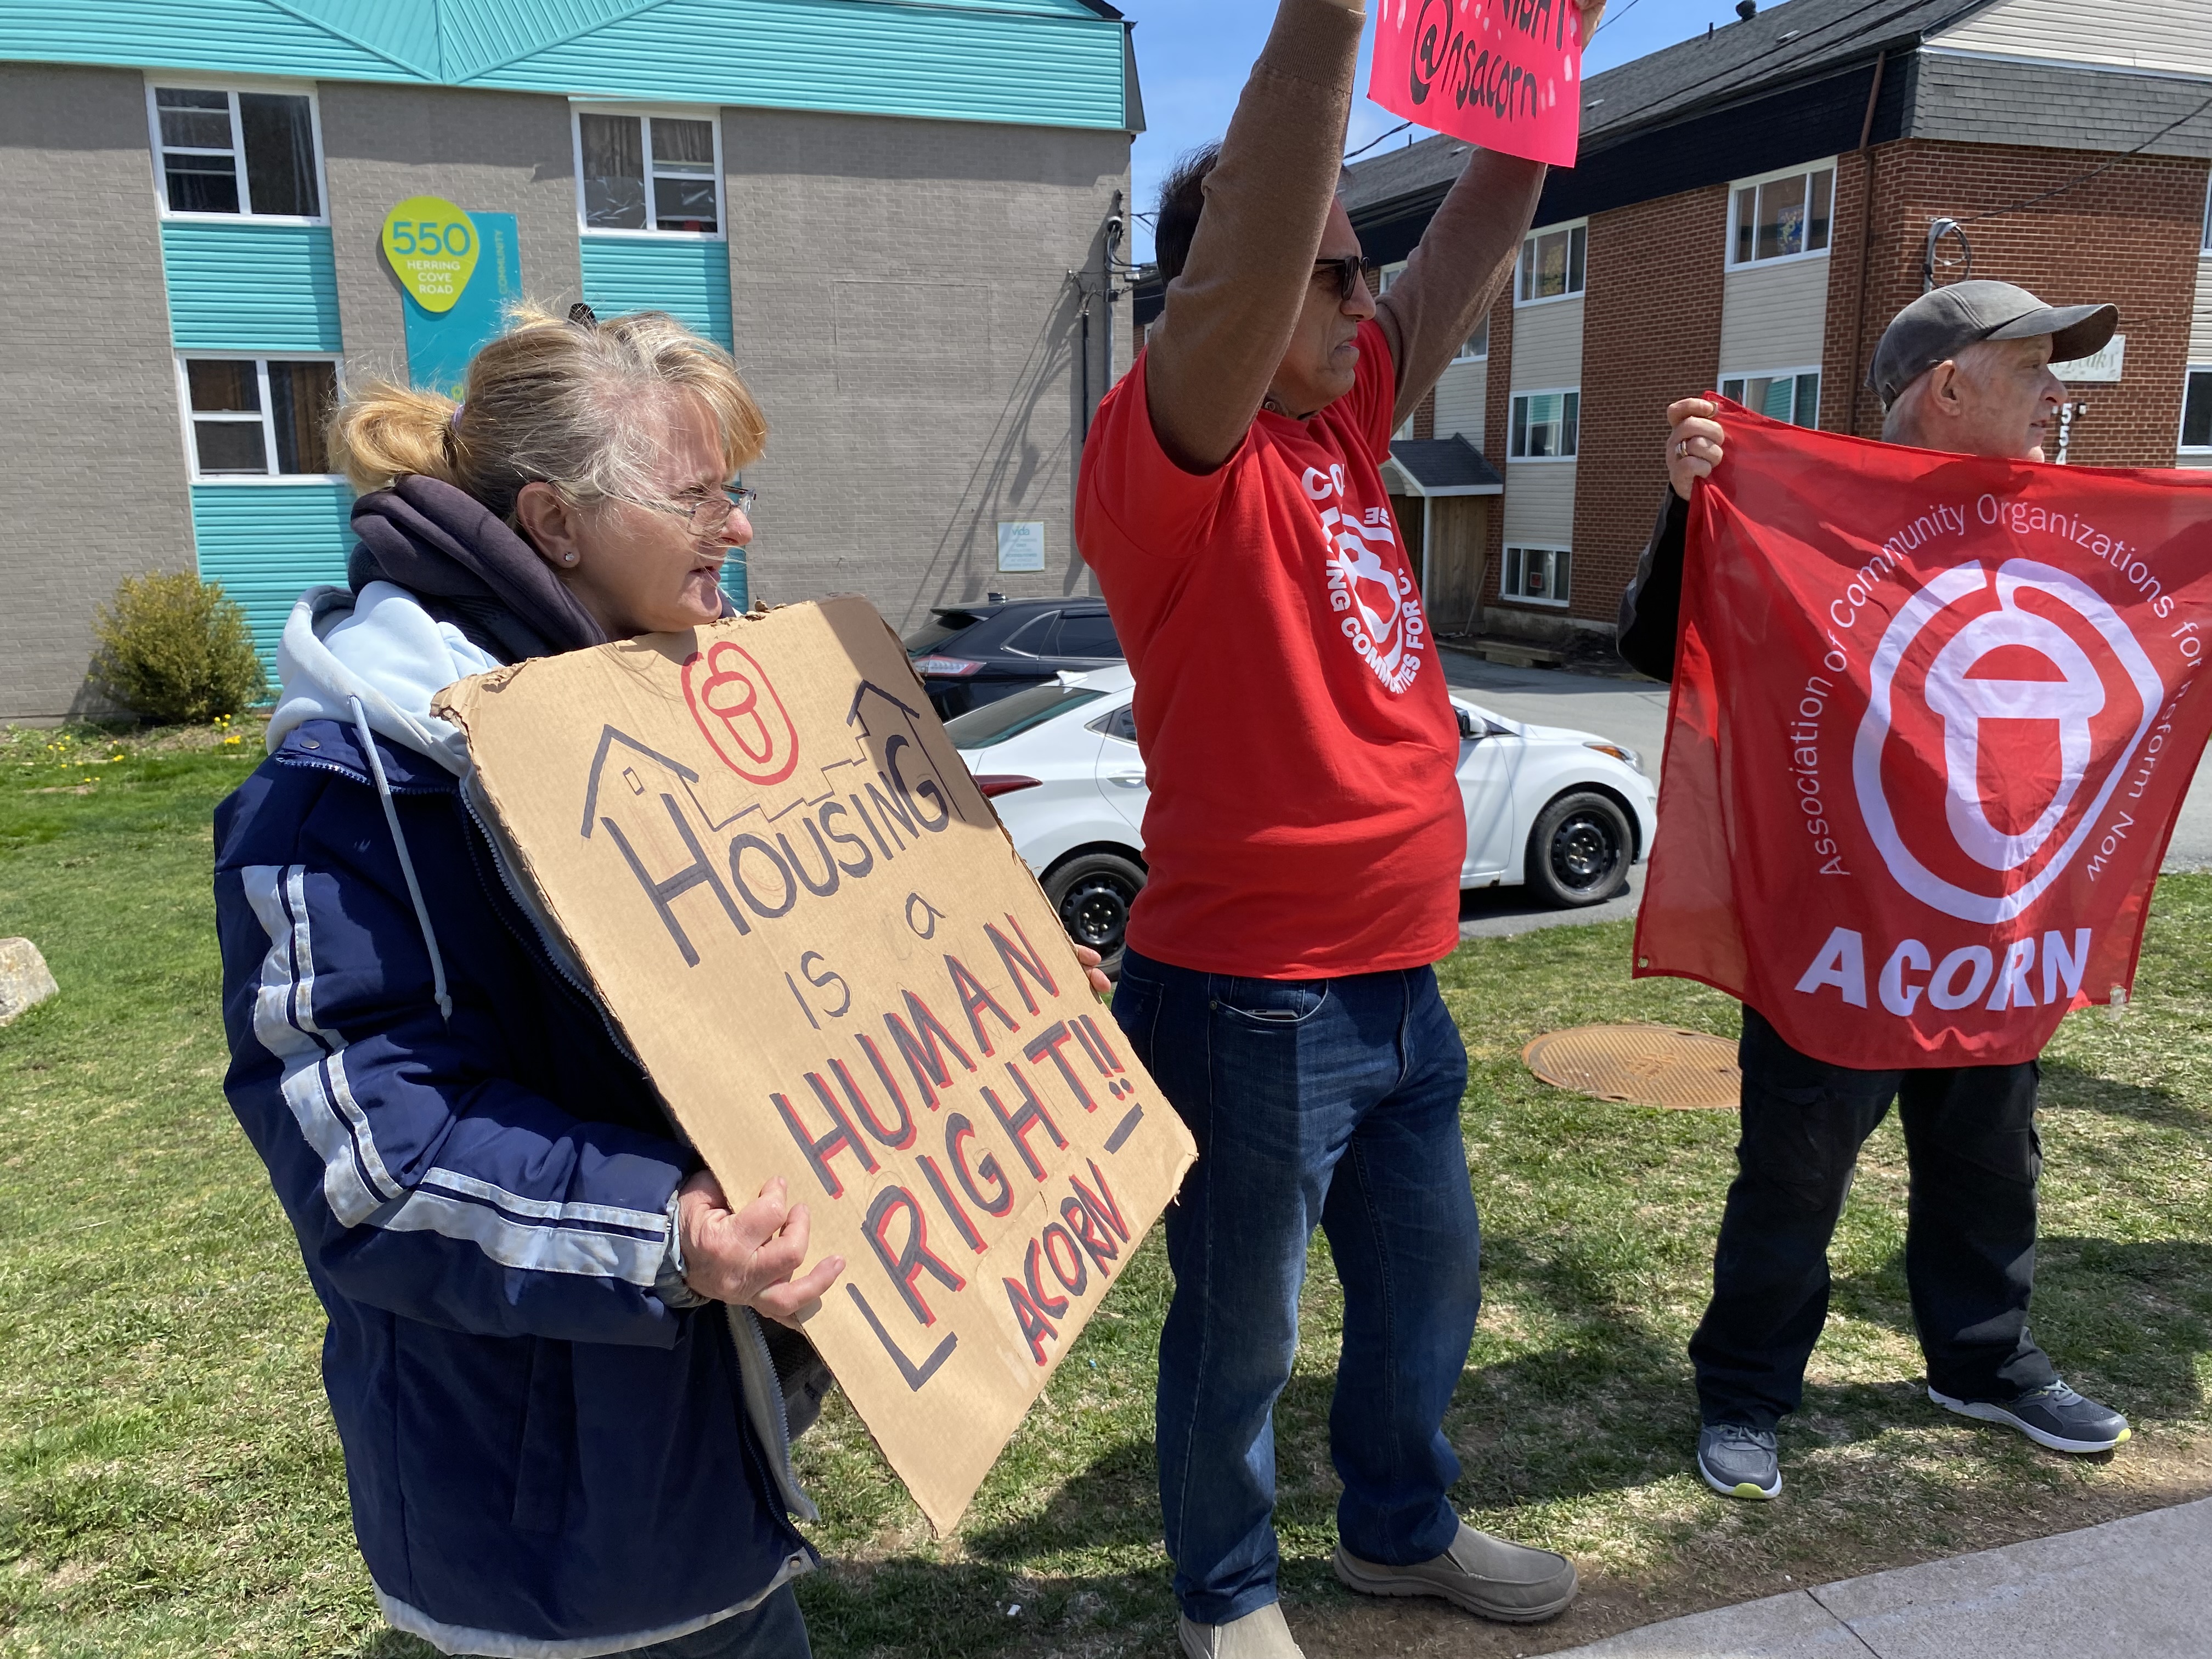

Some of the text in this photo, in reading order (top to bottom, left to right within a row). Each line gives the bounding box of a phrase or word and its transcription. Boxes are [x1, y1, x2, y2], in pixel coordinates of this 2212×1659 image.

[392, 221, 471, 256] 550
[407, 260, 460, 270] HERRING
[417, 273, 453, 282] COVE
[495, 229, 508, 295] COMMUNITY
[419, 284, 453, 294] ROAD
[1830, 503, 1966, 629] Community
[1977, 493, 2174, 619] Organizations
[1402, 600, 1424, 650] FOR
[1824, 629, 1847, 672] of
[2171, 621, 2202, 667] for
[1789, 675, 1850, 877] Association
[601, 734, 949, 968] HOUSING
[785, 891, 946, 1030] IS a
[1795, 926, 2091, 1017] ACORN
[769, 913, 1060, 1199] HUMAN
[860, 1014, 1133, 1327] RIGHT!!
[1002, 1157, 1131, 1367] ACORN
